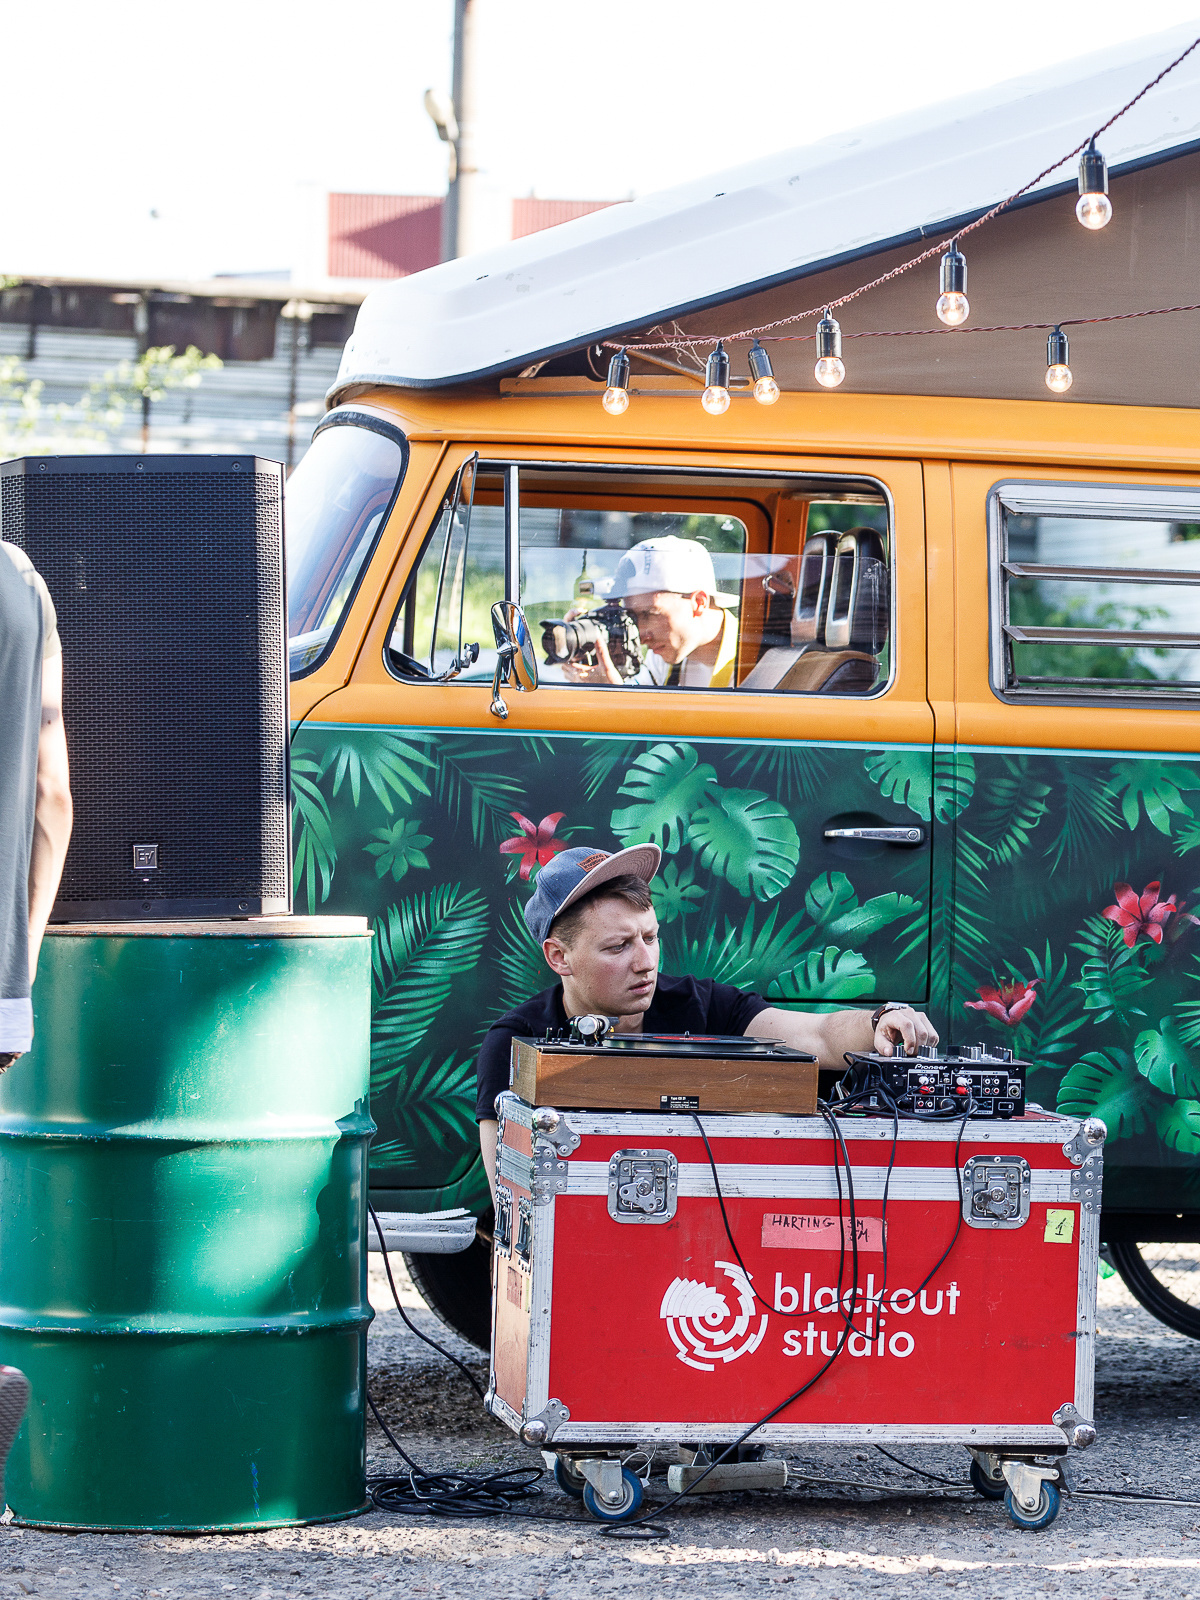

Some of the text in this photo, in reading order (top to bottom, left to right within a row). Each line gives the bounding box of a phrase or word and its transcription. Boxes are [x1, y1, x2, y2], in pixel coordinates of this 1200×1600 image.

[771, 1214, 835, 1231] HARTING
[1055, 1217, 1067, 1236] 1
[774, 1272, 961, 1315] blackout
[782, 1317, 915, 1358] studio
